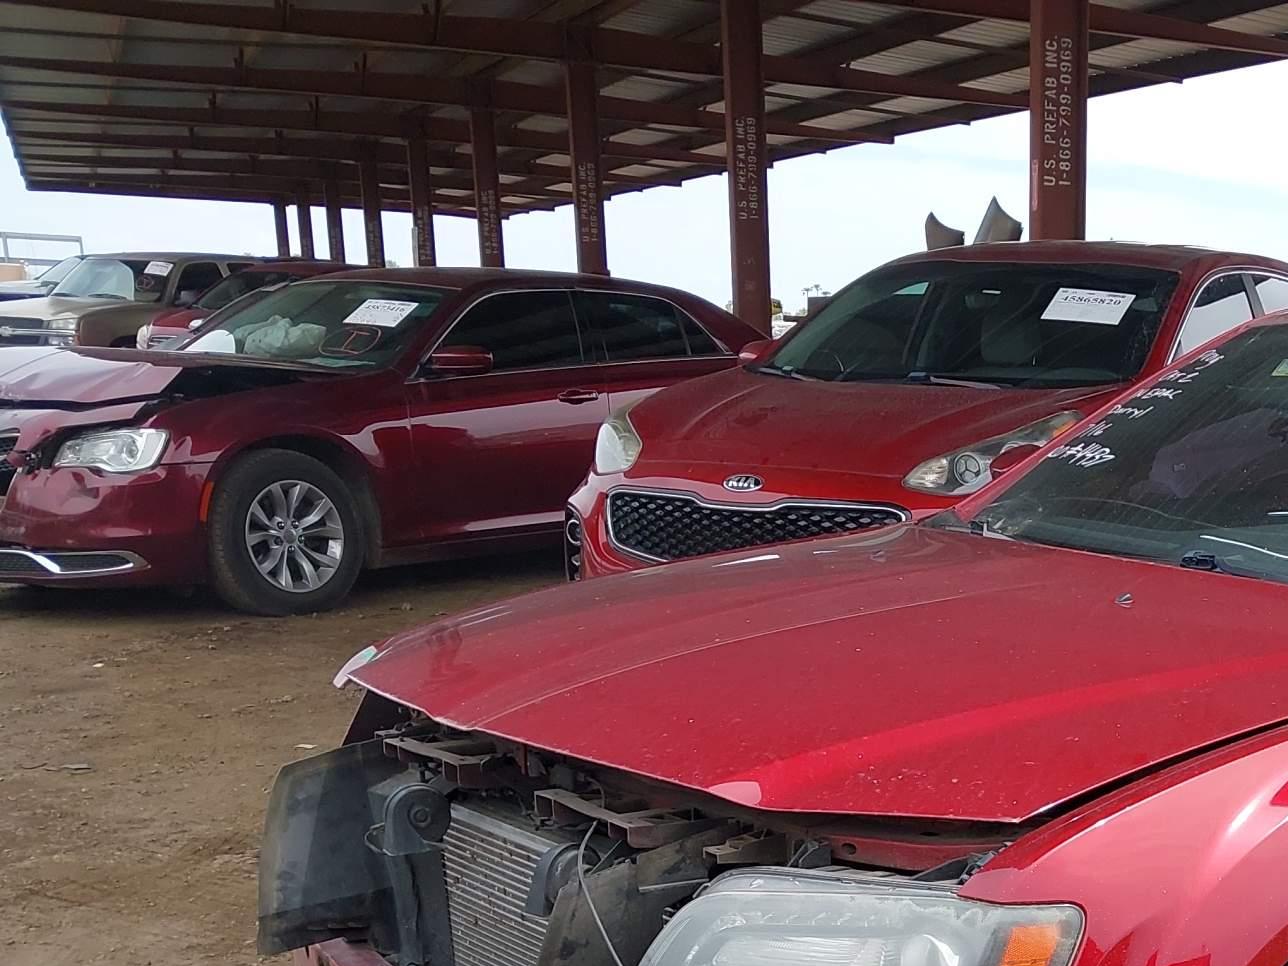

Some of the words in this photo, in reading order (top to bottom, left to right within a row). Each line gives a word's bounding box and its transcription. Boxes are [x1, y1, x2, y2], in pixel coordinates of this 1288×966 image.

[1045, 35, 1058, 68] INC.
[1043, 77, 1058, 144] PREFAB
[1058, 37, 1073, 186] 1-866-799-0969
[736, 144, 747, 191] PREFAB
